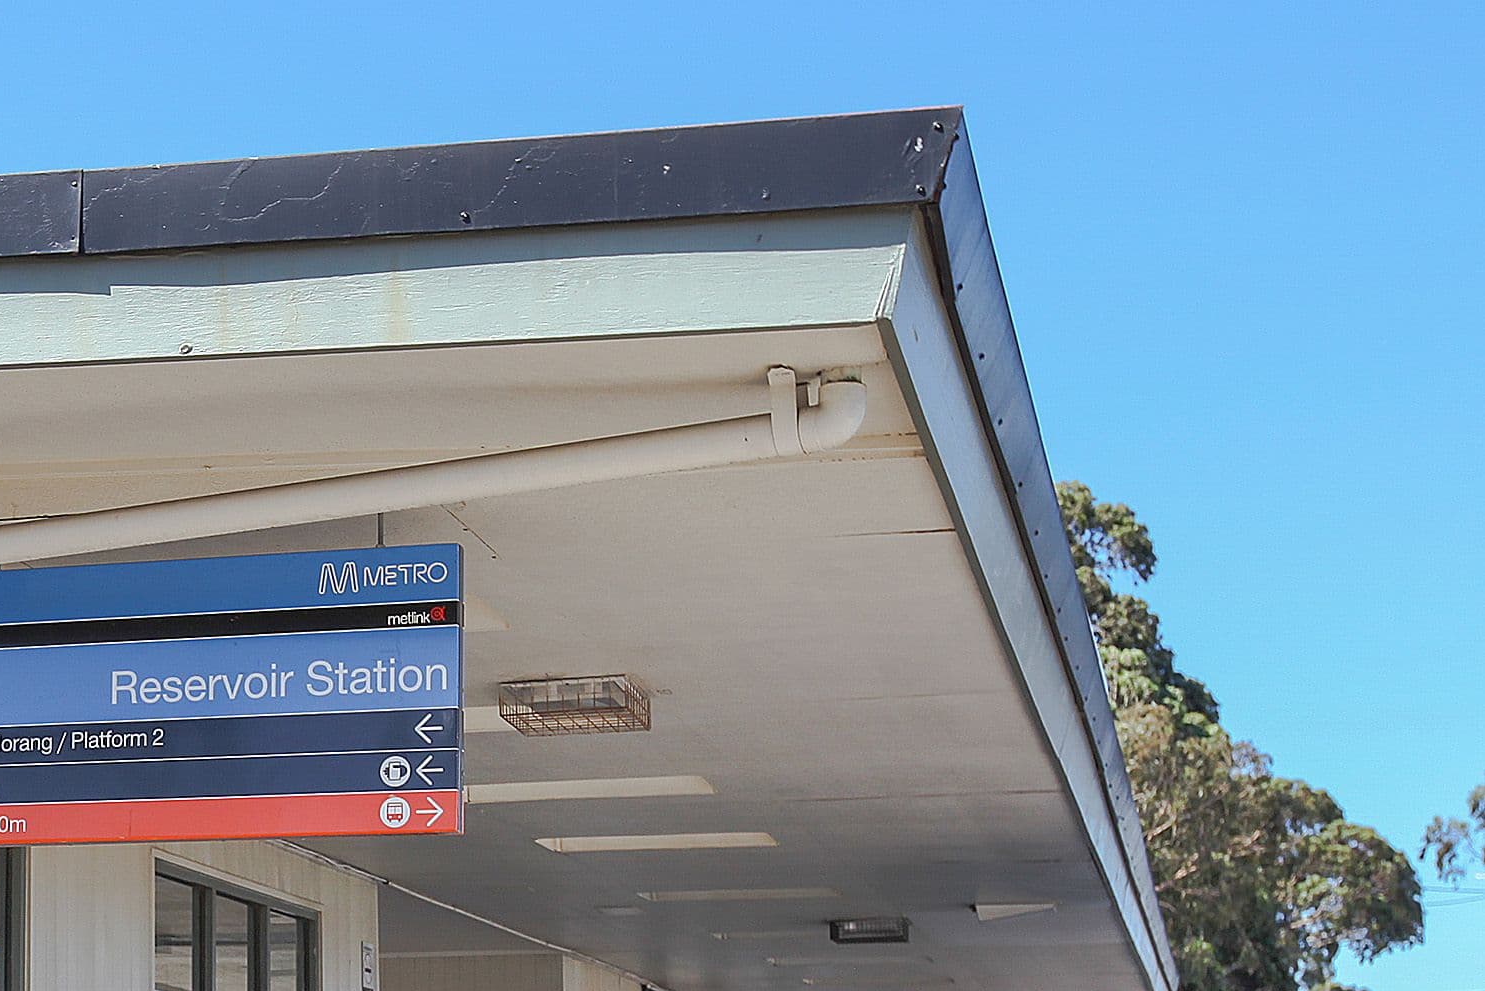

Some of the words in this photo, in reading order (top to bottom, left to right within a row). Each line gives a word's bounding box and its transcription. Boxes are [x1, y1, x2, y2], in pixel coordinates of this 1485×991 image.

[363, 561, 448, 588] METRO
[387, 610, 431, 626] metlink
[111, 663, 294, 705] Reservoir
[306, 657, 448, 697] Station
[56, 732, 67, 755] /
[71, 730, 148, 750] Platform
[152, 728, 164, 747] 2
